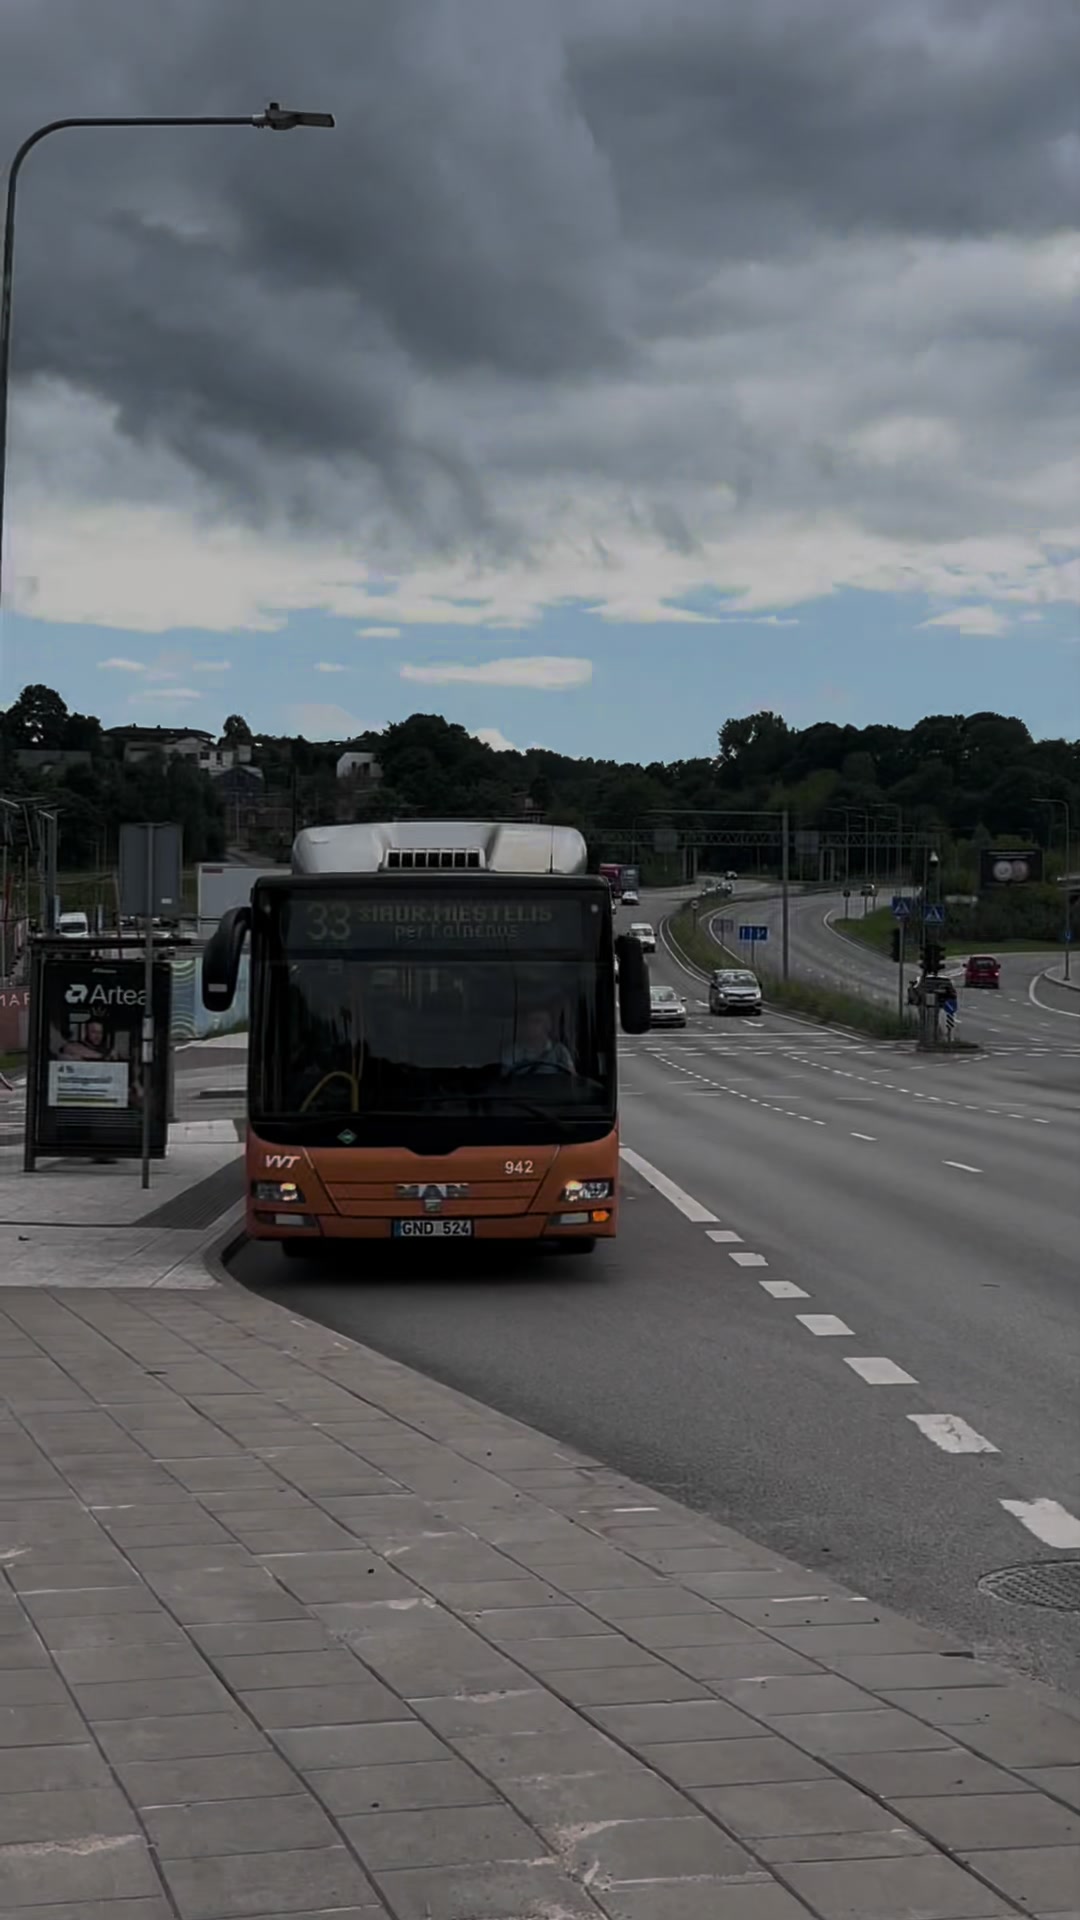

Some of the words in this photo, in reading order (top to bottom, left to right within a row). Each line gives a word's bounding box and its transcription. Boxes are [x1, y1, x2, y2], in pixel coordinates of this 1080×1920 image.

[306, 901, 351, 940] 33
[265, 1154, 301, 1168] VVT
[505, 1160, 534, 1174] 942
[402, 1221, 434, 1235] GND
[443, 1221, 469, 1235] 524
